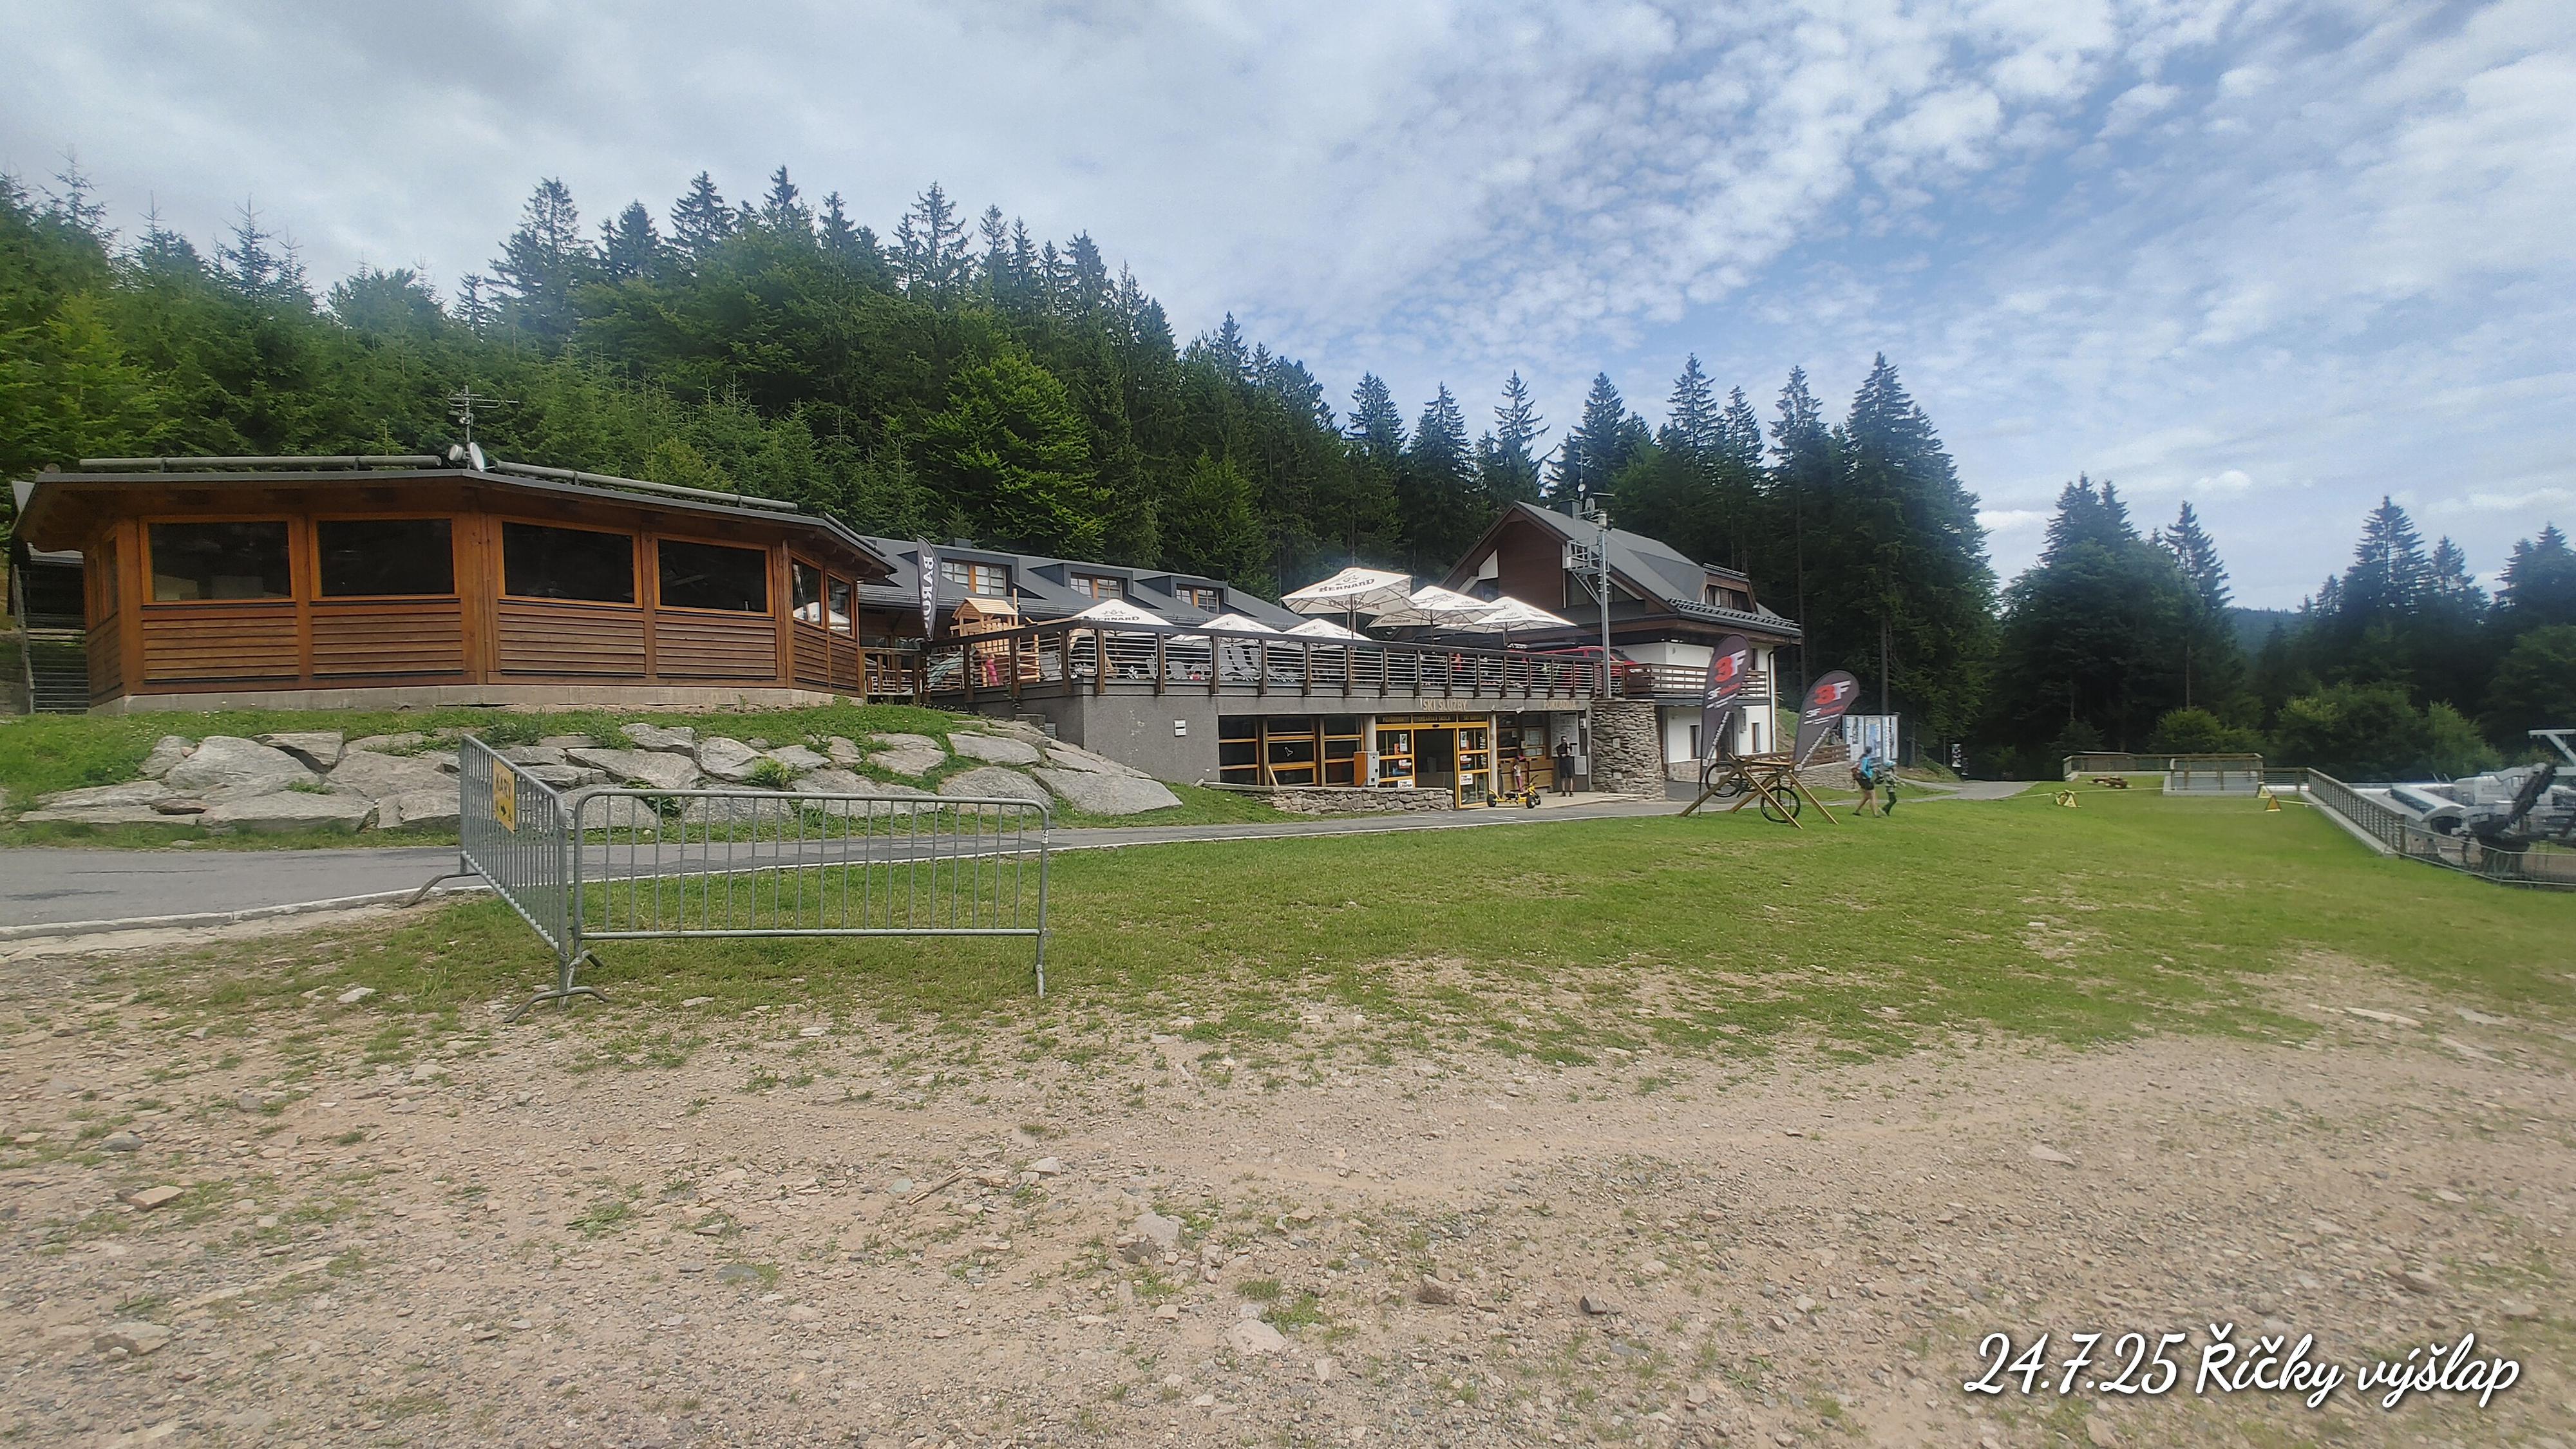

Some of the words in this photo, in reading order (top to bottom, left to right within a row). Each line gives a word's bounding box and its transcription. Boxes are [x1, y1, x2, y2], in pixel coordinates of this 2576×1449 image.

[1319, 578, 1375, 592] BERNARD
[1714, 649, 1747, 683] 3F
[1814, 680, 1851, 705] 3F
[1423, 698, 1436, 711] SKI
[1438, 698, 1468, 711] SLUŽBY
